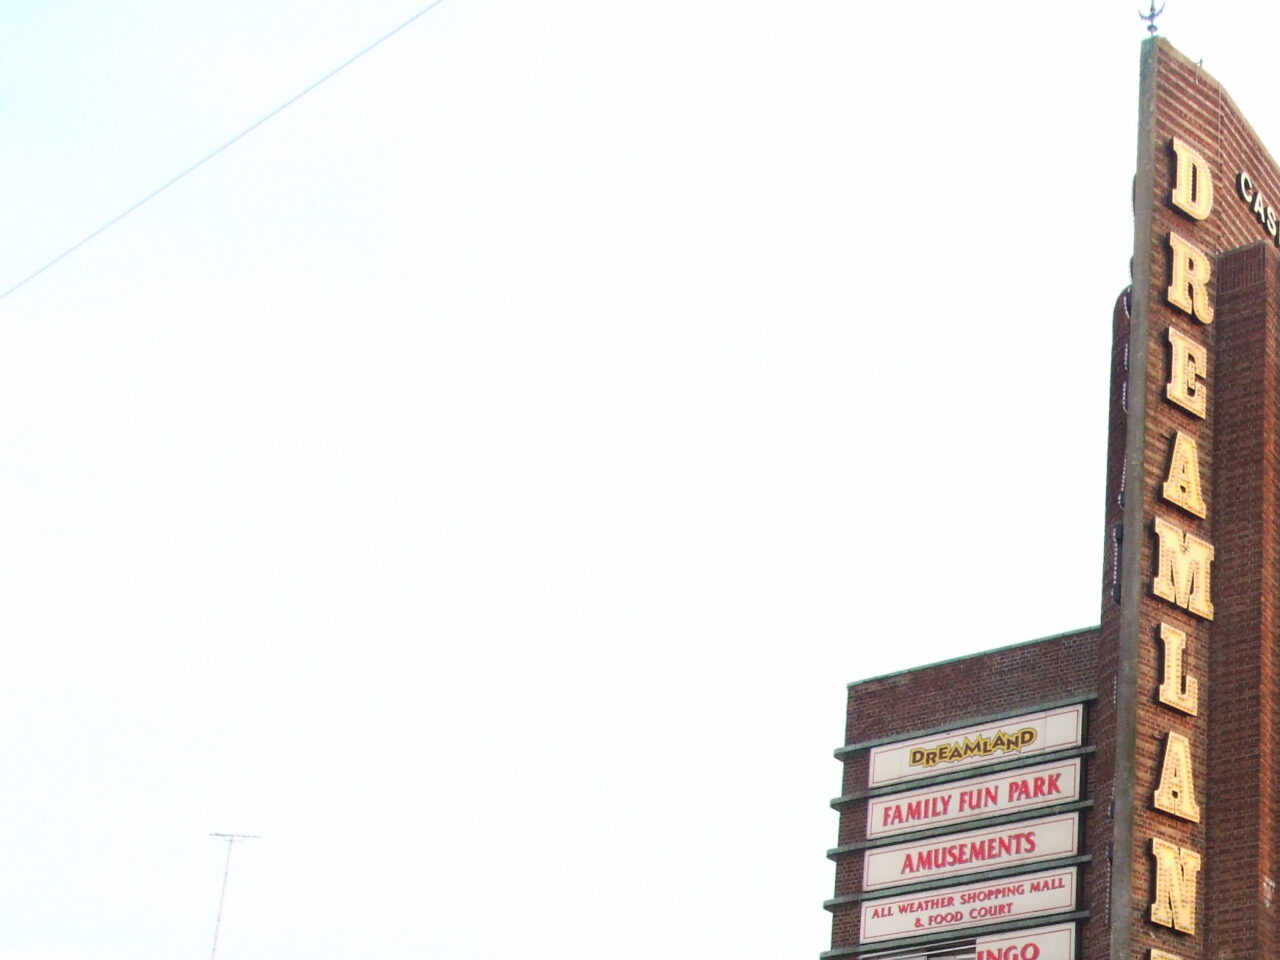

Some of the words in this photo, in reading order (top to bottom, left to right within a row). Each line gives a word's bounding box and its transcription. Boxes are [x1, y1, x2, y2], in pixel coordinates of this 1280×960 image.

[910, 728, 1037, 767] DREAMLAND
[882, 795, 952, 827] FAMILY
[958, 785, 999, 812] FUN
[1008, 773, 1062, 803] PARK
[900, 831, 1037, 875] AMUSEMENTS
[872, 906, 894, 919] ALL
[898, 895, 955, 915] WEATHER
[960, 884, 1025, 905] SHOPPING
[1029, 877, 1066, 893] MALL
[914, 917, 925, 928] &
[928, 911, 964, 926] FOOD
[969, 902, 1014, 920] COURT
